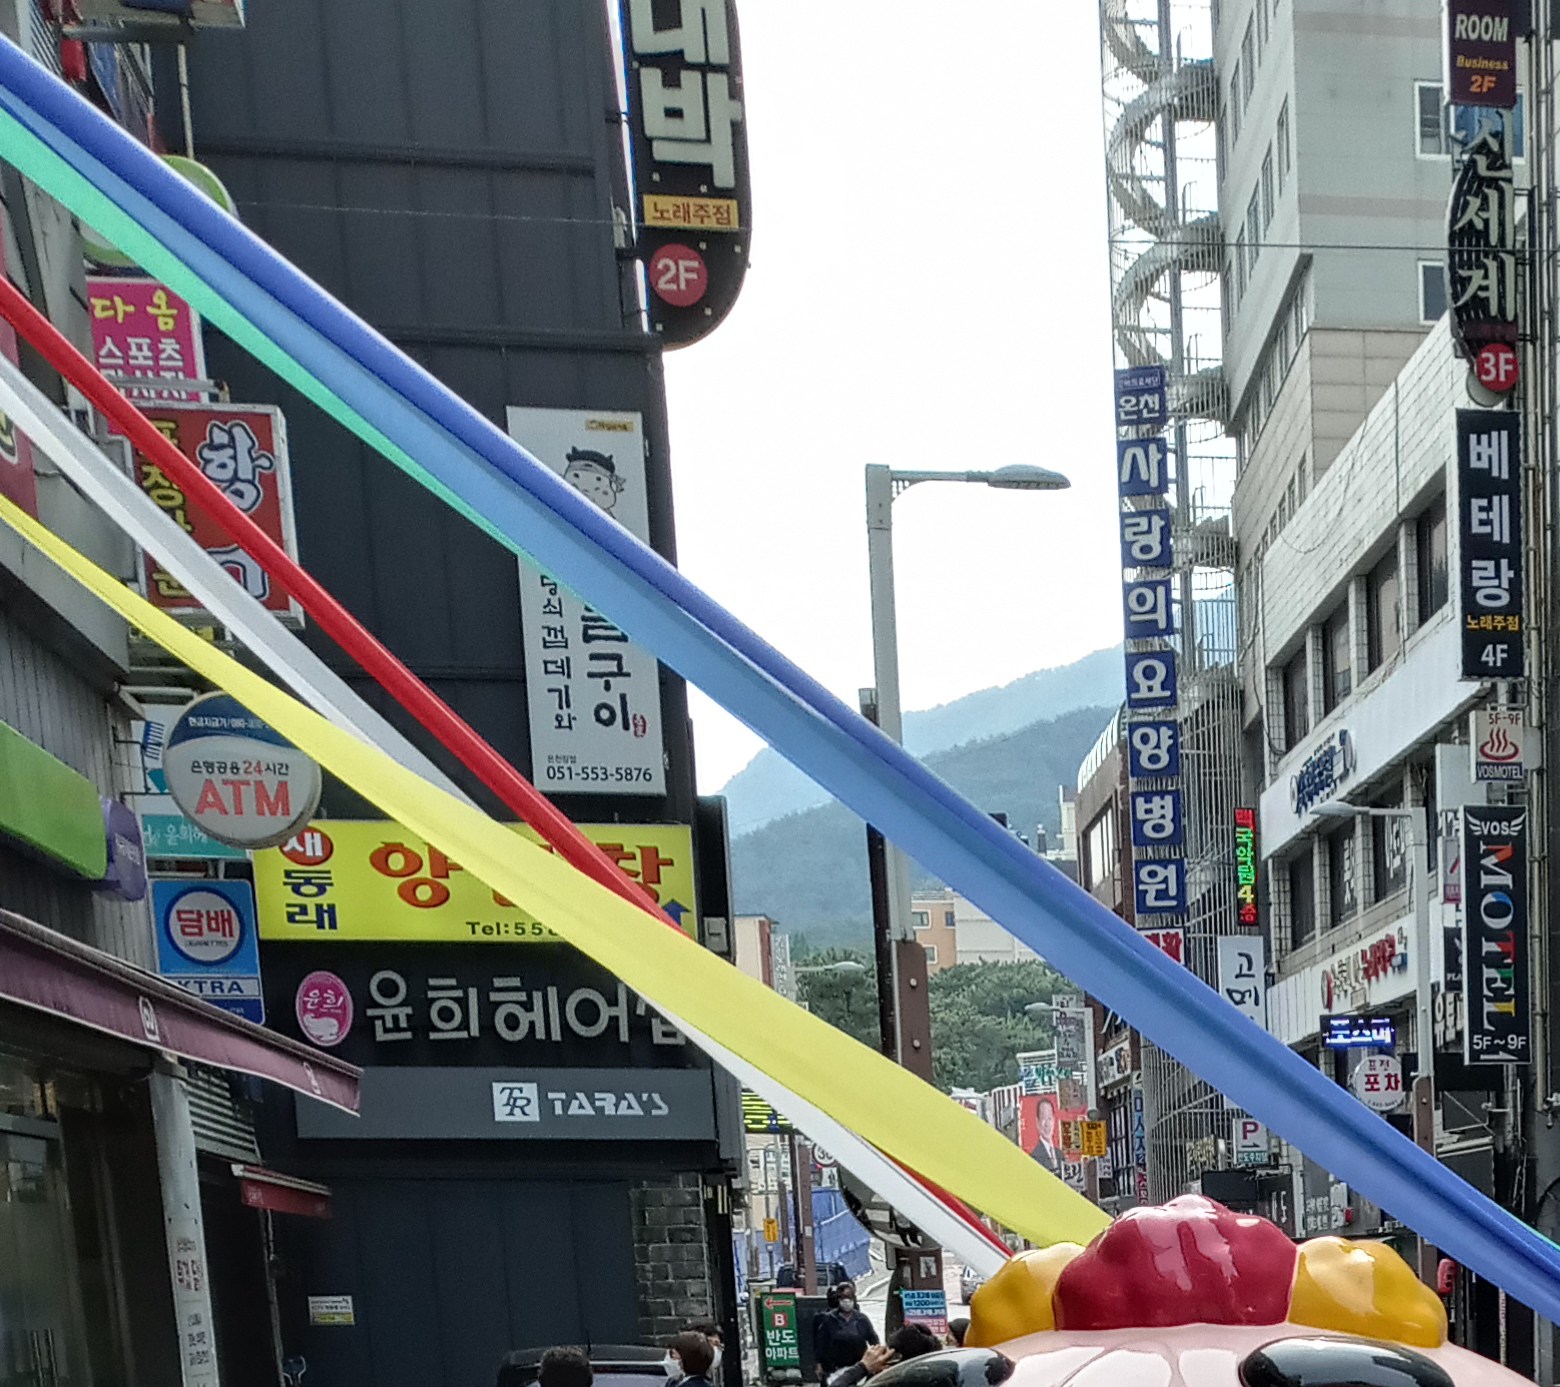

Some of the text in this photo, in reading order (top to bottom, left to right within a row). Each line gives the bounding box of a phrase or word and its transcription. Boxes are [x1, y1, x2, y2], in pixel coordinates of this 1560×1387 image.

[1455, 13, 1509, 42] ROOM
[1456, 54, 1509, 70] Business
[1470, 75, 1497, 93] 2F
[652, 201, 731, 226] 노래주점
[1454, 107, 1516, 322] 신세계
[657, 258, 699, 291] 2F
[98, 337, 183, 367] 스포츠
[1481, 352, 1513, 383] 3F
[1119, 393, 1160, 420] 온천
[1469, 430, 1514, 608] 베테랑
[1466, 615, 1520, 632] 노래주점
[1481, 644, 1508, 668] 4F
[546, 765, 653, 782] 051-553-5876
[195, 778, 292, 818] ATM
[1480, 821, 1509, 836] VOS
[176, 908, 235, 938] 담배
[1480, 840, 1516, 1032] MOTEL
[1364, 1073, 1401, 1092] 포차
[547, 1091, 670, 1117] TARA'S
[1242, 1121, 1260, 1140] P
[774, 1313, 785, 1327] B
[766, 1329, 796, 1346] 반도
[765, 1347, 800, 1360] 아파트
